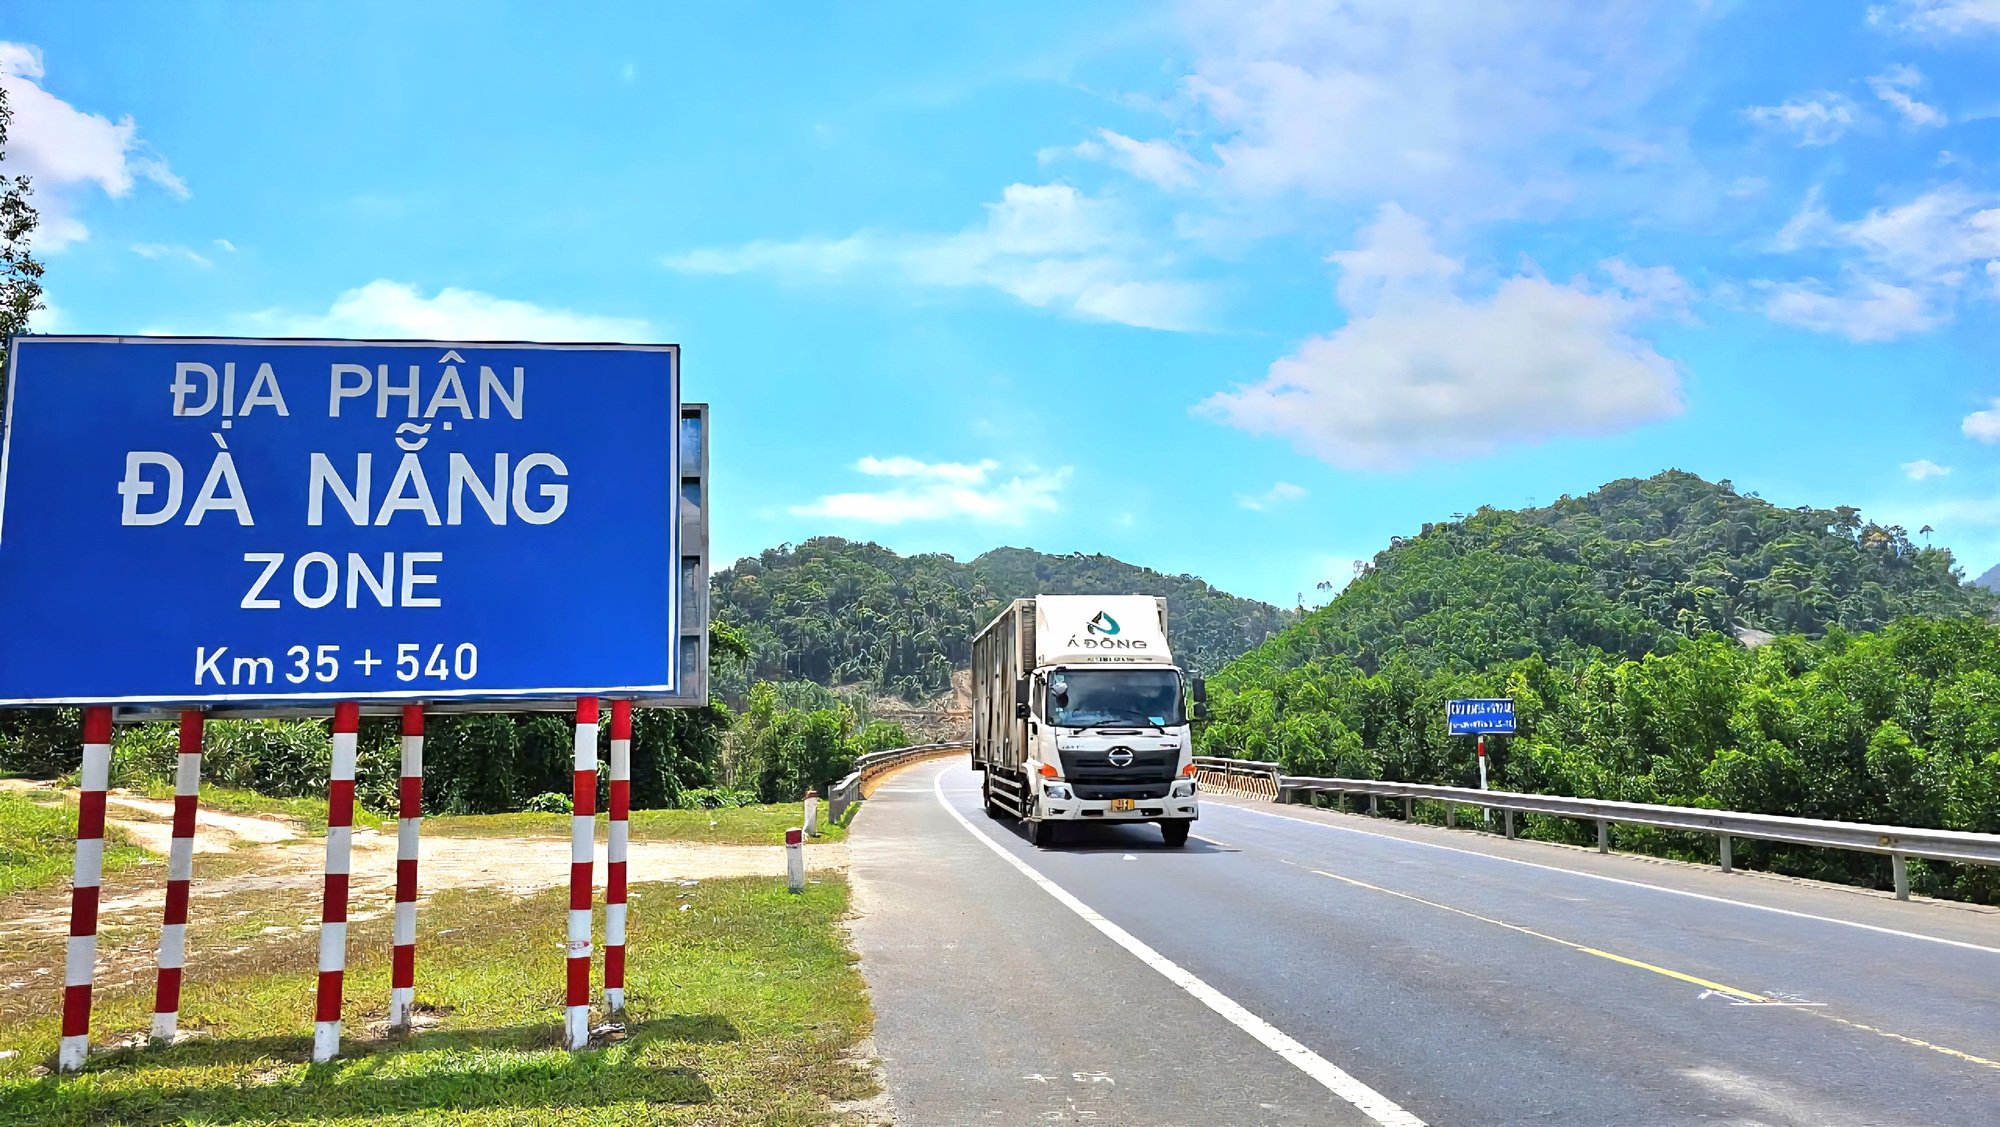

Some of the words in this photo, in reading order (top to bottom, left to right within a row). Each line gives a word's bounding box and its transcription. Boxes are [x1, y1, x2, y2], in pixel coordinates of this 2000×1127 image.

[169, 361, 290, 430] ĐỊA
[328, 350, 524, 431] PHẬN
[117, 432, 255, 526] ĐÀ
[307, 422, 569, 526] NẴNG
[240, 551, 443, 609] ZONE
[194, 645, 274, 686] Km
[285, 644, 340, 684] 35
[396, 642, 479, 682] 540
